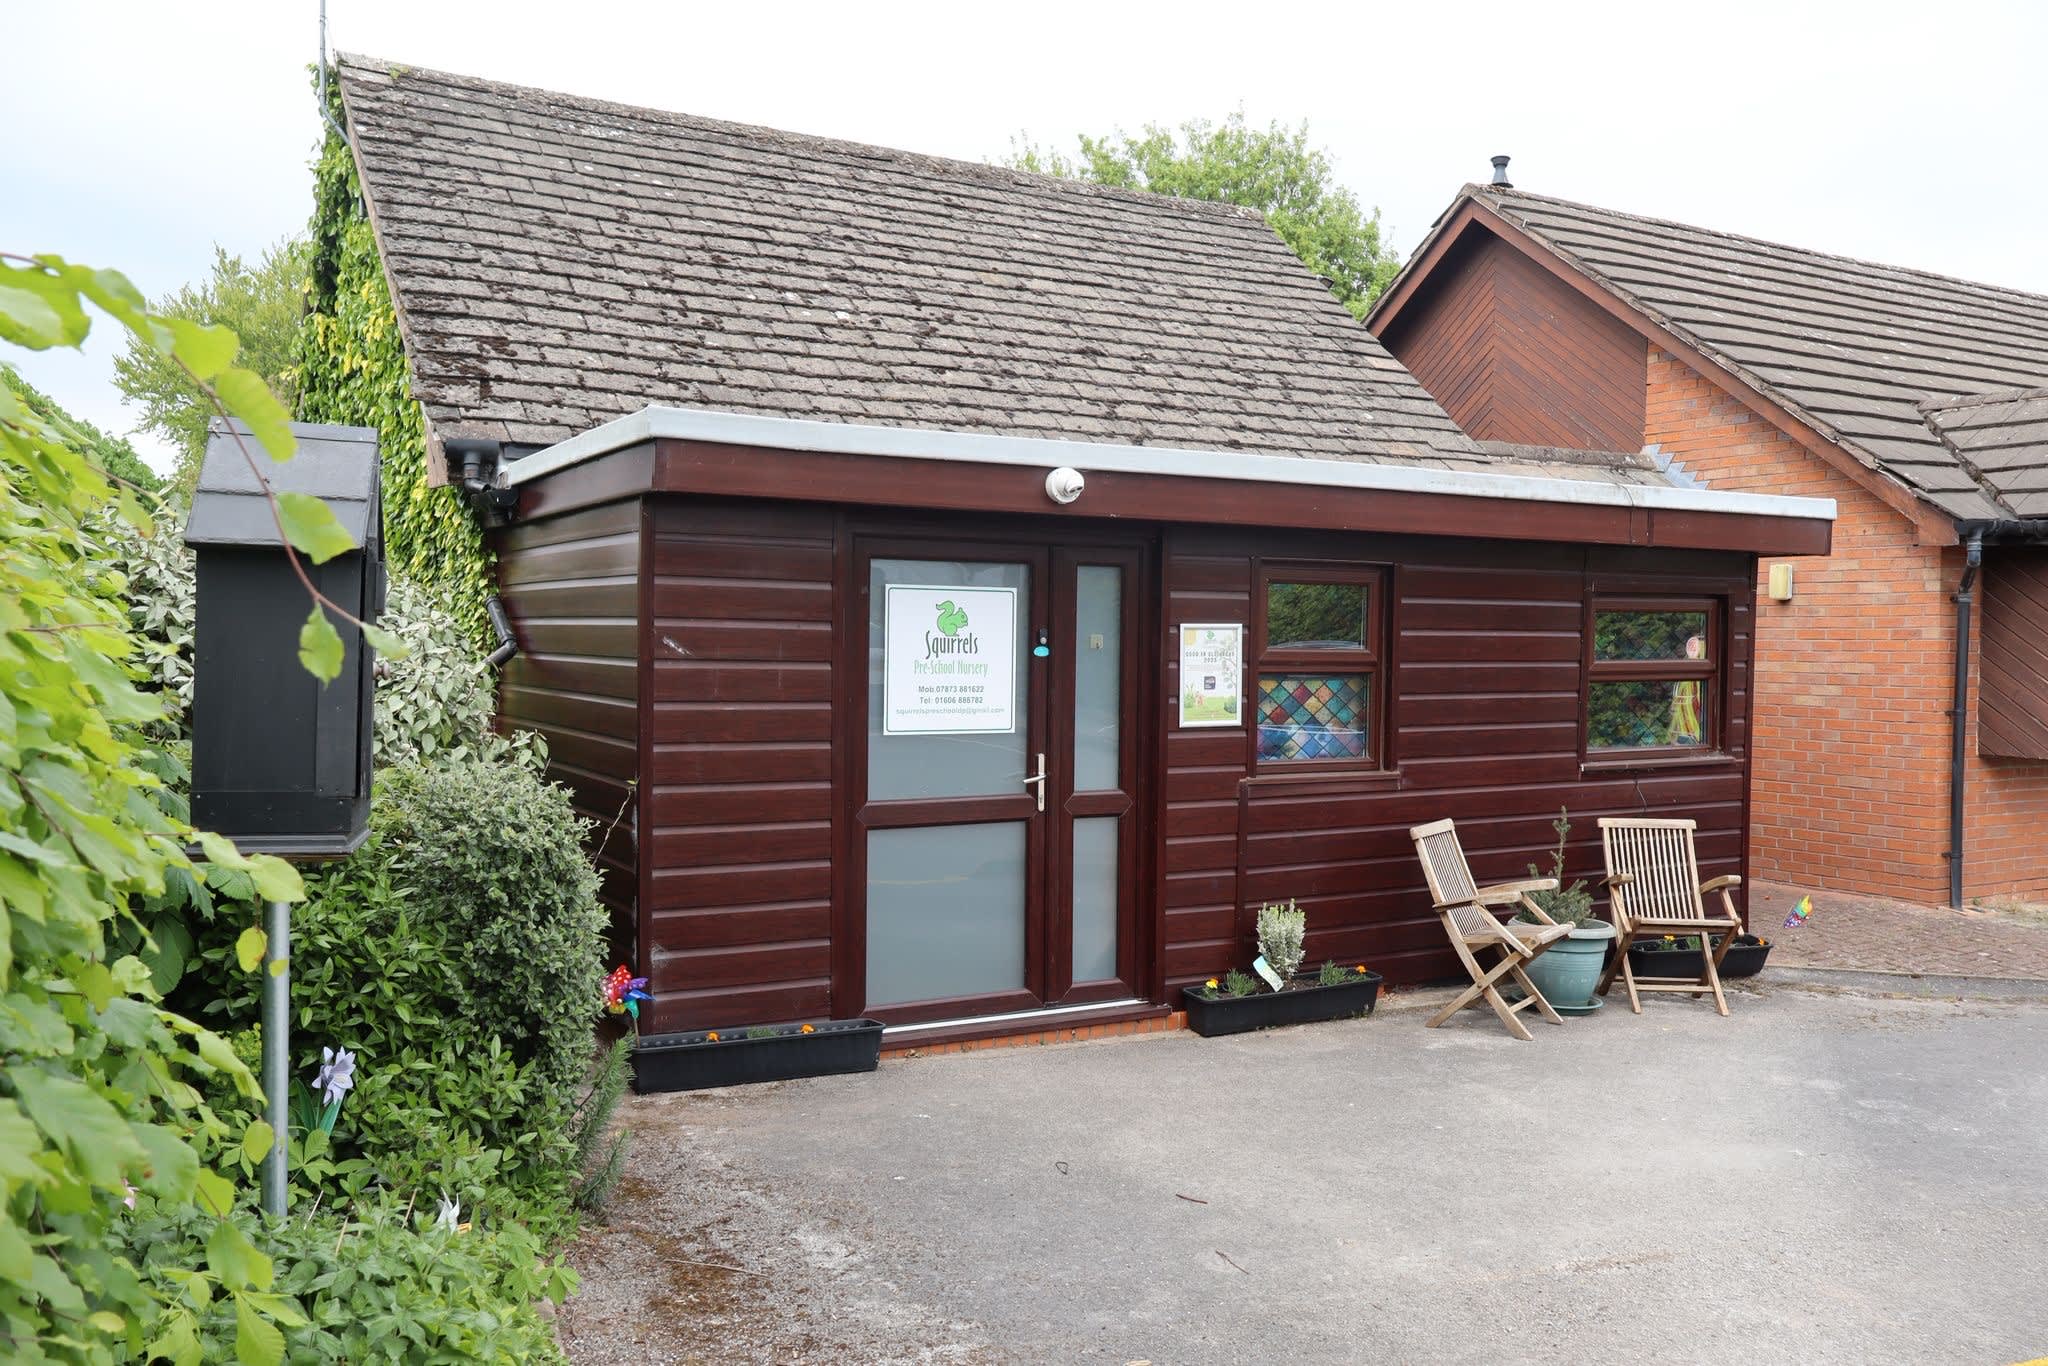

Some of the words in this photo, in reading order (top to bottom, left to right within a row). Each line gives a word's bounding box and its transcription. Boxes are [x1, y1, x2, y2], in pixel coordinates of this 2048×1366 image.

[925, 630, 978, 660] Squirrels
[913, 659, 955, 675] Pre-School
[957, 660, 988, 677] Nursery
[935, 696, 956, 704] 01606
